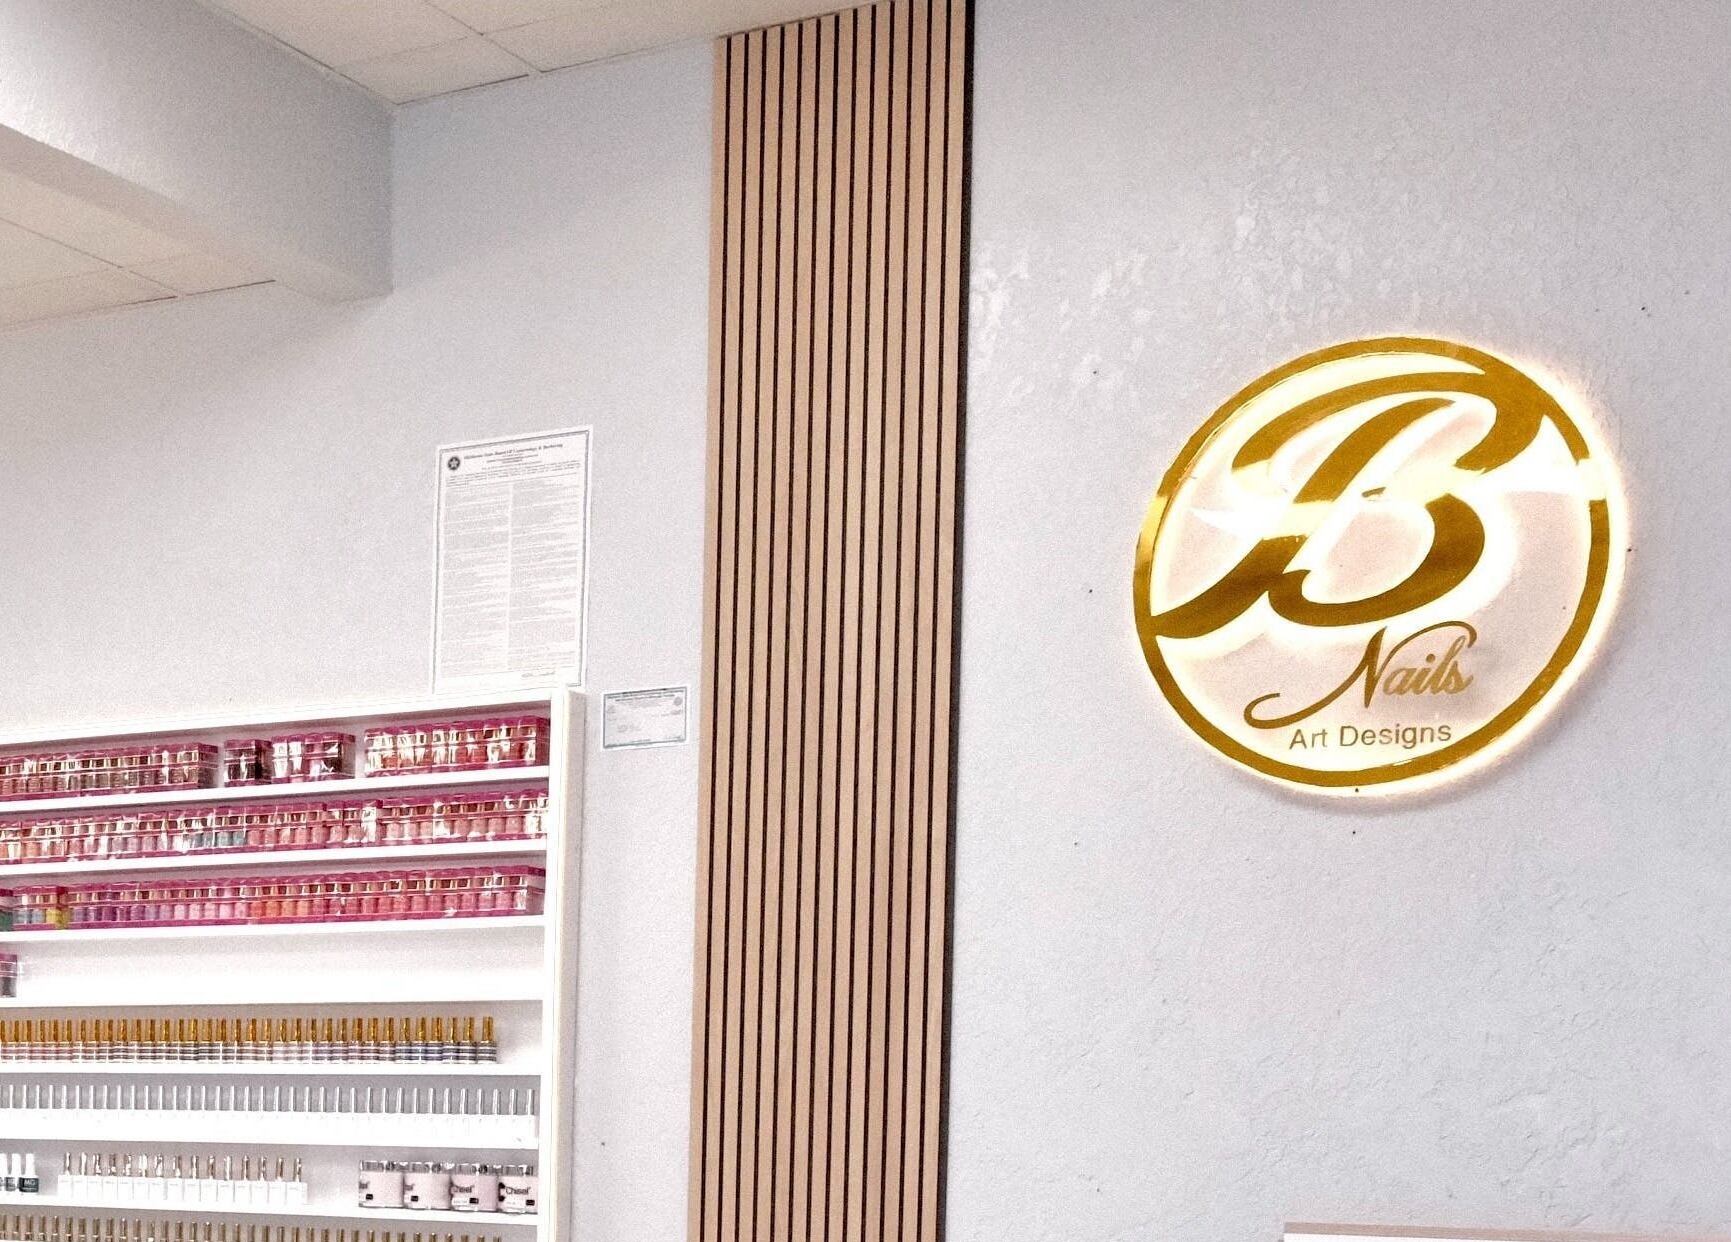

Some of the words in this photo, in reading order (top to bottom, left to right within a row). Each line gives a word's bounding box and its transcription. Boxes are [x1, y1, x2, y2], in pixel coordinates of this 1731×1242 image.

[1243, 620, 1478, 729] Nails
[1289, 727, 1328, 750] Art
[1339, 723, 1452, 750] Designs
